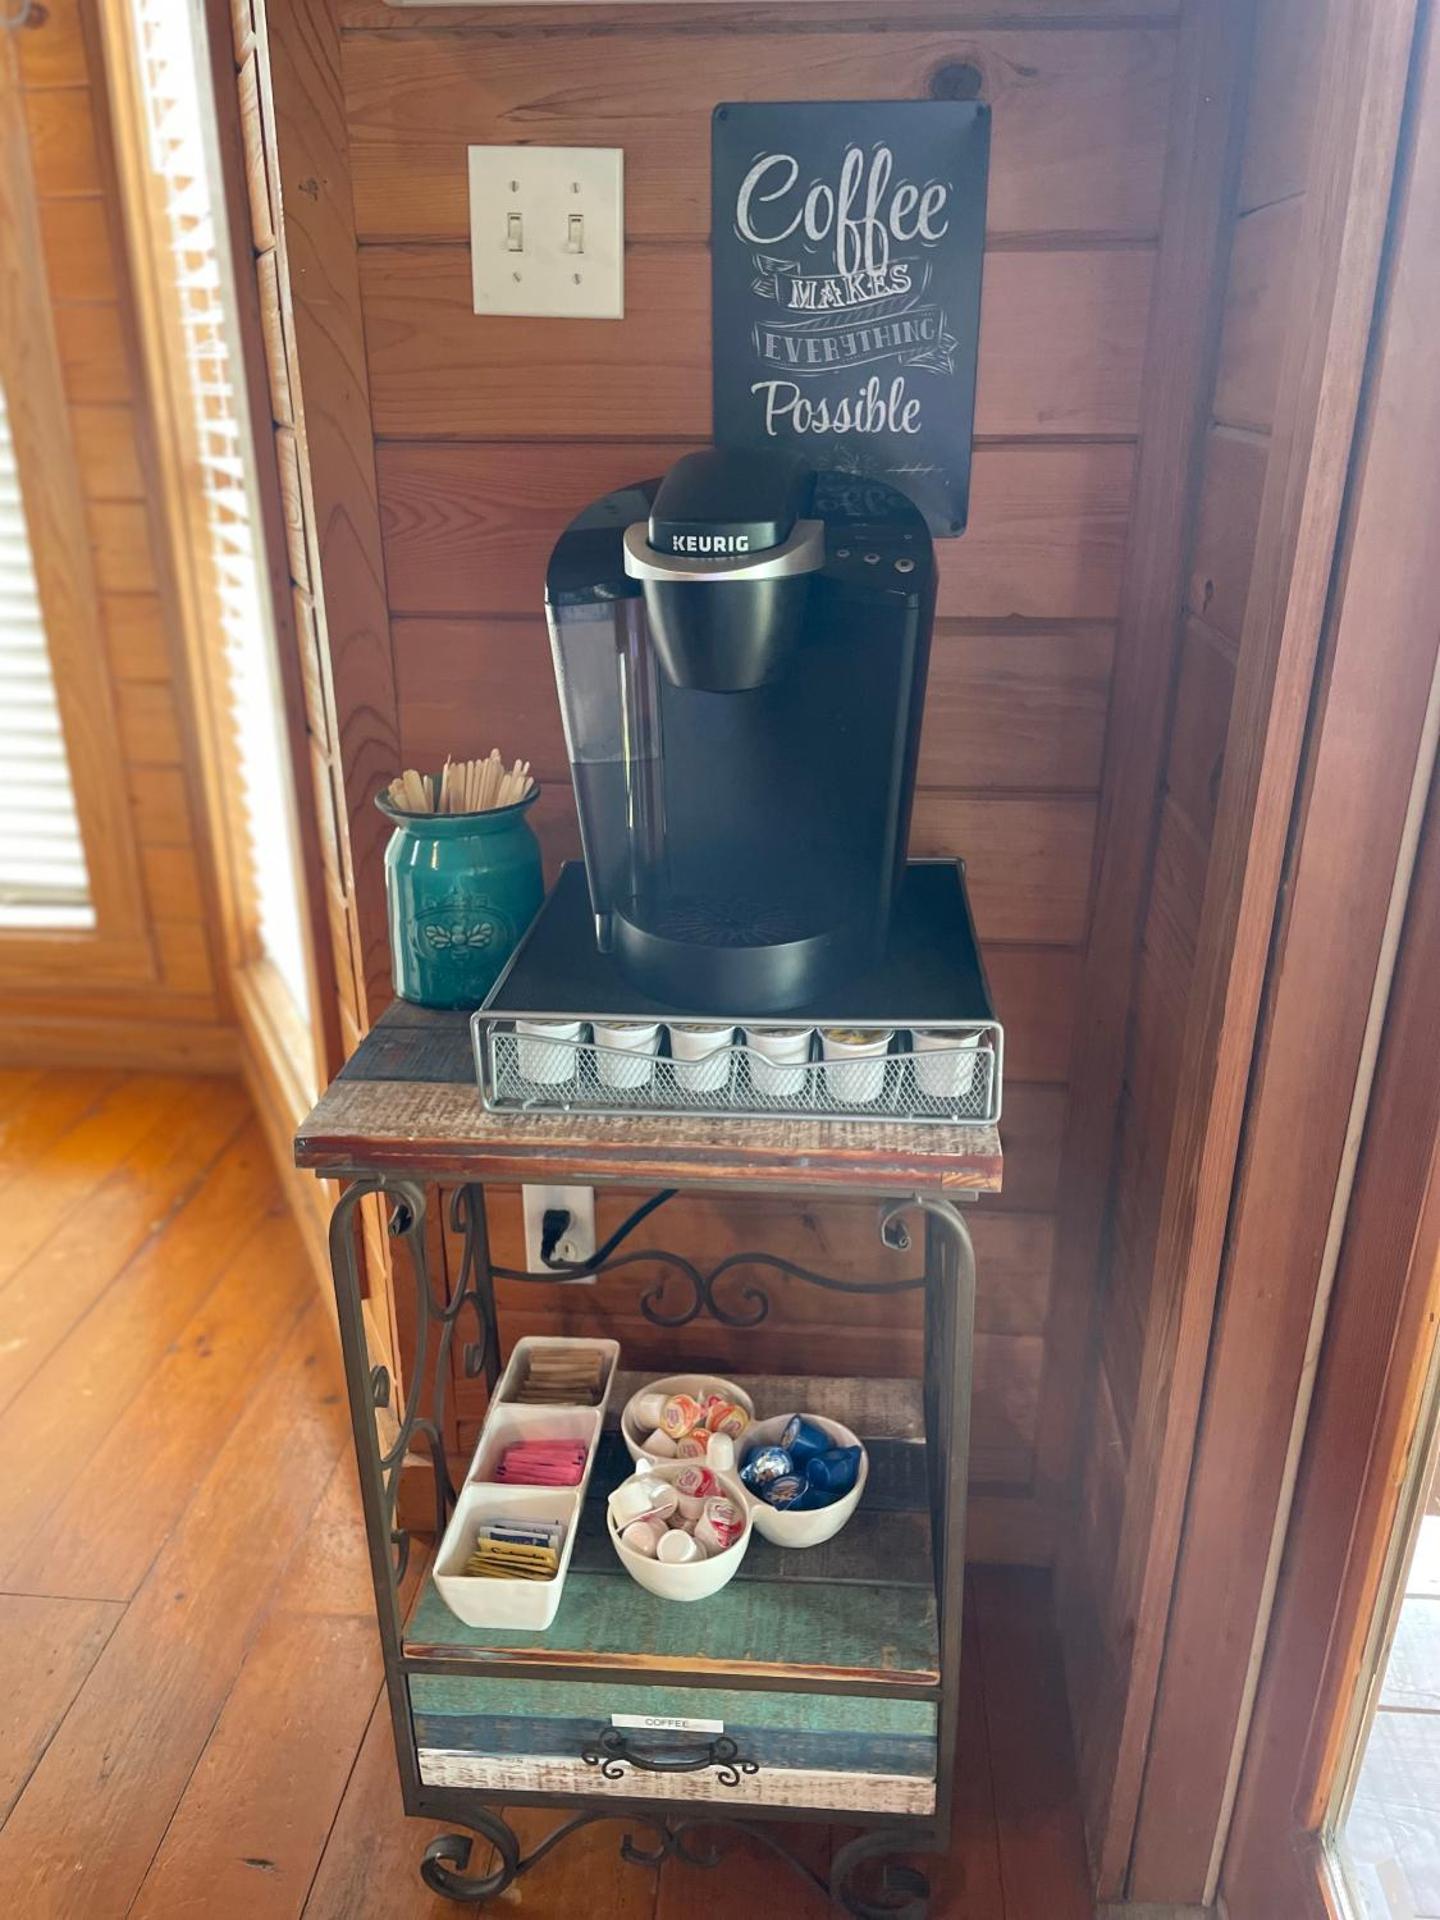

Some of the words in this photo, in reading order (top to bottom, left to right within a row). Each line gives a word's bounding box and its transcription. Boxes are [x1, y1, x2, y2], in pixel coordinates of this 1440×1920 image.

[736, 147, 948, 277] Coffee
[787, 263, 911, 309] MAKES
[764, 317, 936, 363] EVERYTHING
[751, 376, 921, 436] Possible
[672, 535, 749, 553] KEURIG
[645, 1718, 690, 1728] COFFEE
